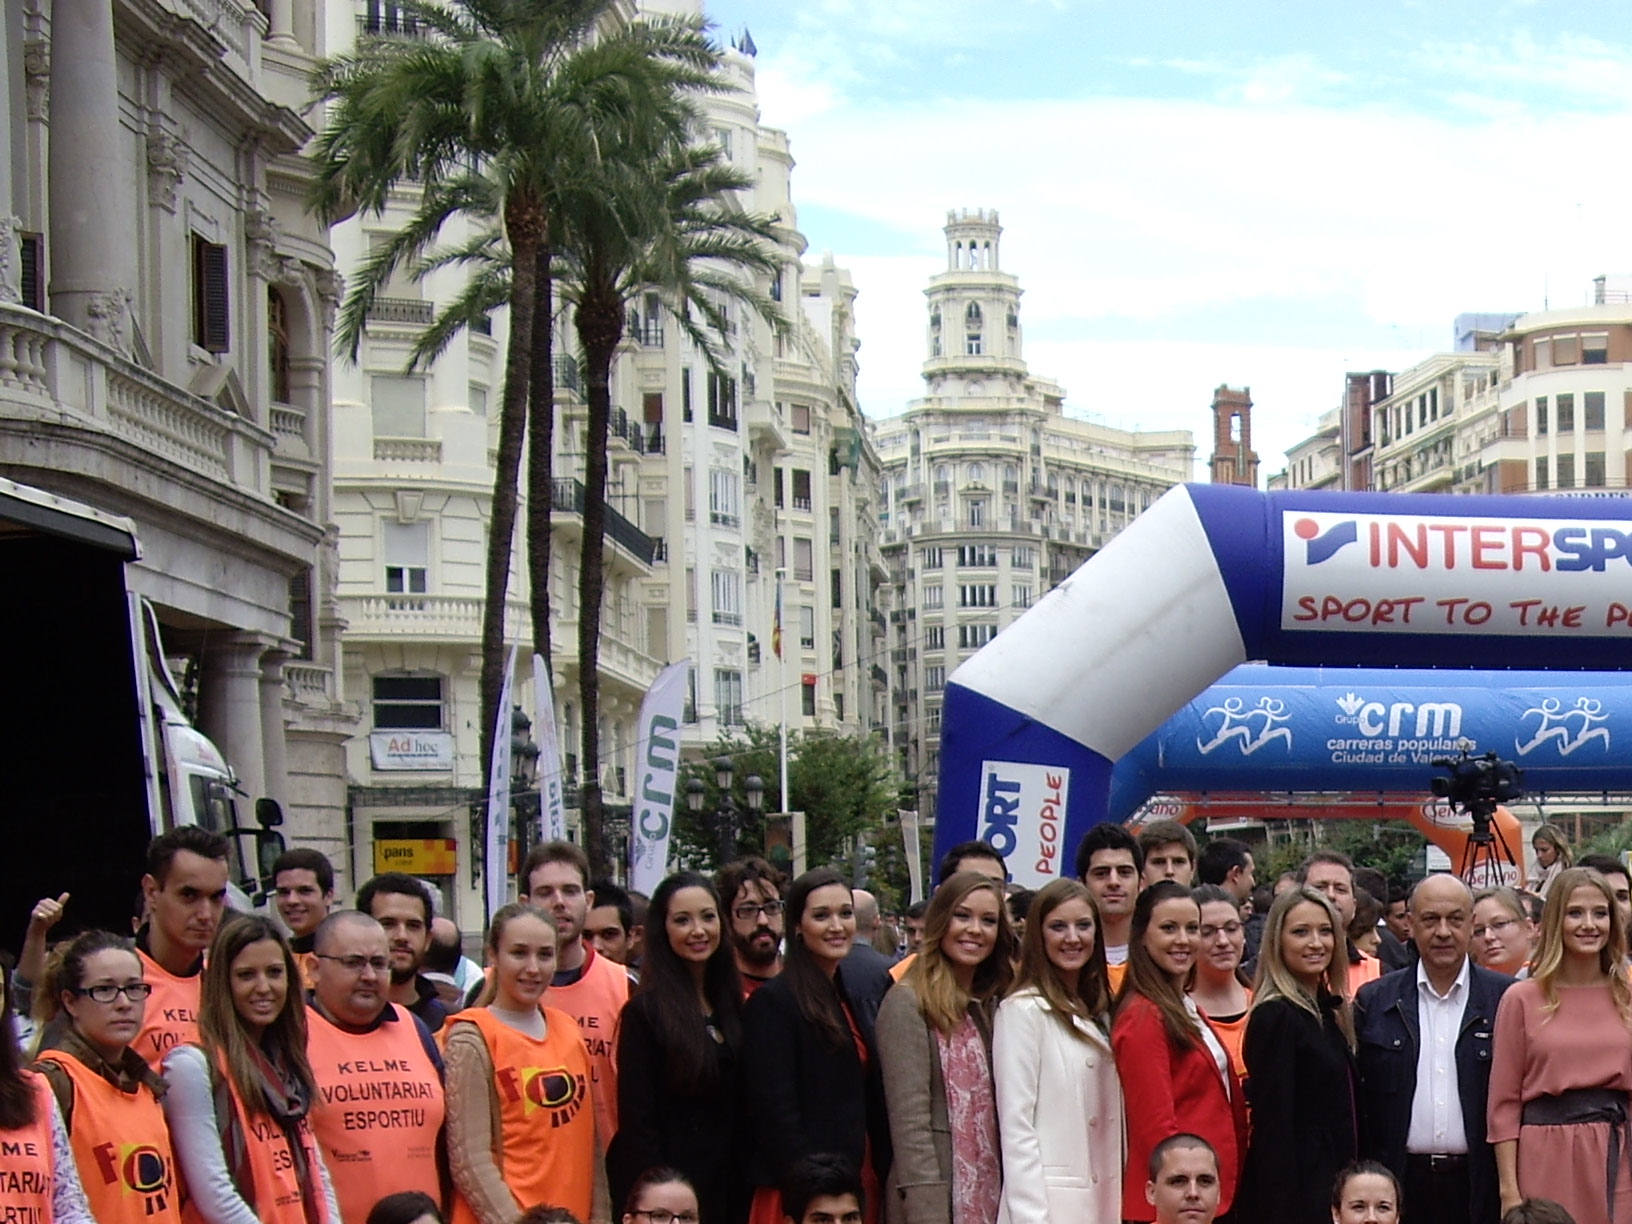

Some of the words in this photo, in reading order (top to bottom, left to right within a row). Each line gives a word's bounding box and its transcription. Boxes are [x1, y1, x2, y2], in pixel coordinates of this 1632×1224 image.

[1293, 595, 1425, 626] SPORT
[1436, 597, 1492, 626] TO
[1509, 599, 1587, 629] THE
[1358, 702, 1462, 737] crm
[387, 738, 411, 752] Ad
[1327, 738, 1393, 751] carreras
[1397, 738, 1477, 755] populars
[1331, 751, 1385, 764] Ciudad
[1388, 751, 1407, 764] de
[639, 713, 678, 842] crm
[1035, 772, 1063, 874] PEOPLE
[337, 1060, 411, 1074] KELME
[321, 1081, 434, 1104] VOLUNTARIAT
[344, 1109, 425, 1130] ESPORTIU
